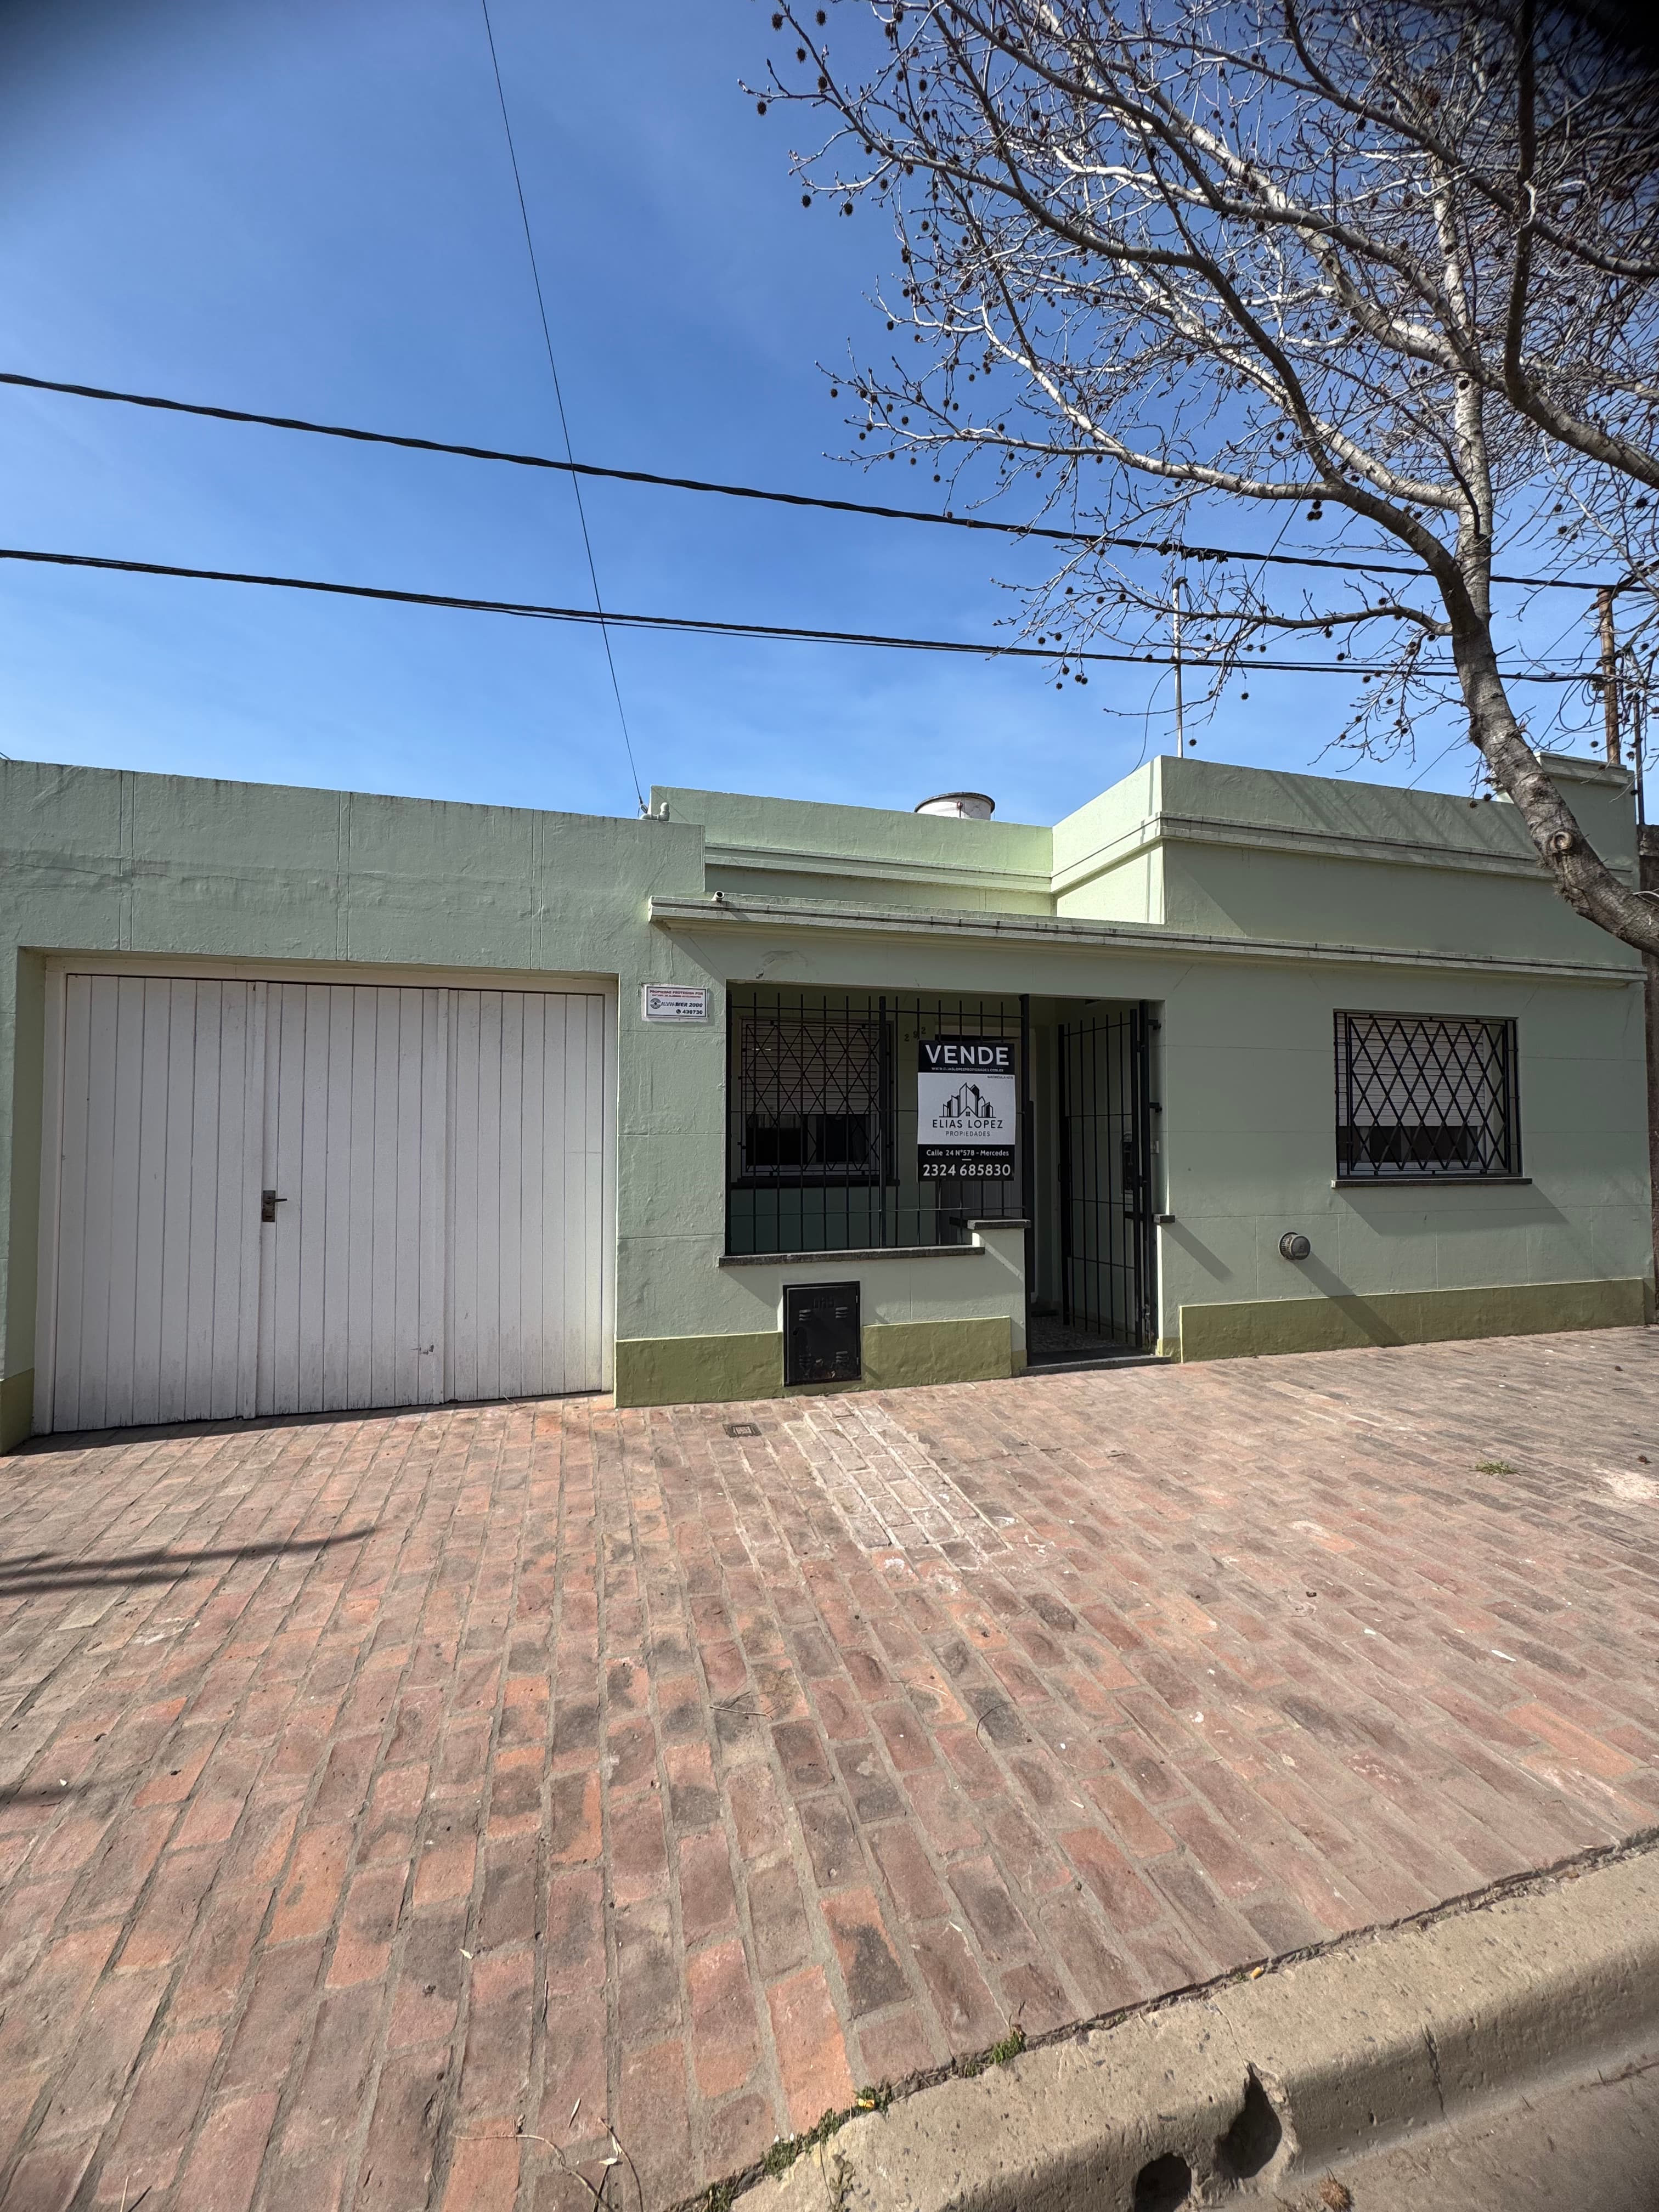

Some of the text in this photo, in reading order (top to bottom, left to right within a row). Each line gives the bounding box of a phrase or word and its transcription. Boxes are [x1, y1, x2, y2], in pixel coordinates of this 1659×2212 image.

[925, 1045, 1009, 1065] VENDE
[932, 1119, 1003, 1128] ELIAS LOPEZ
[923, 1164, 1011, 1176] 2324 685830
